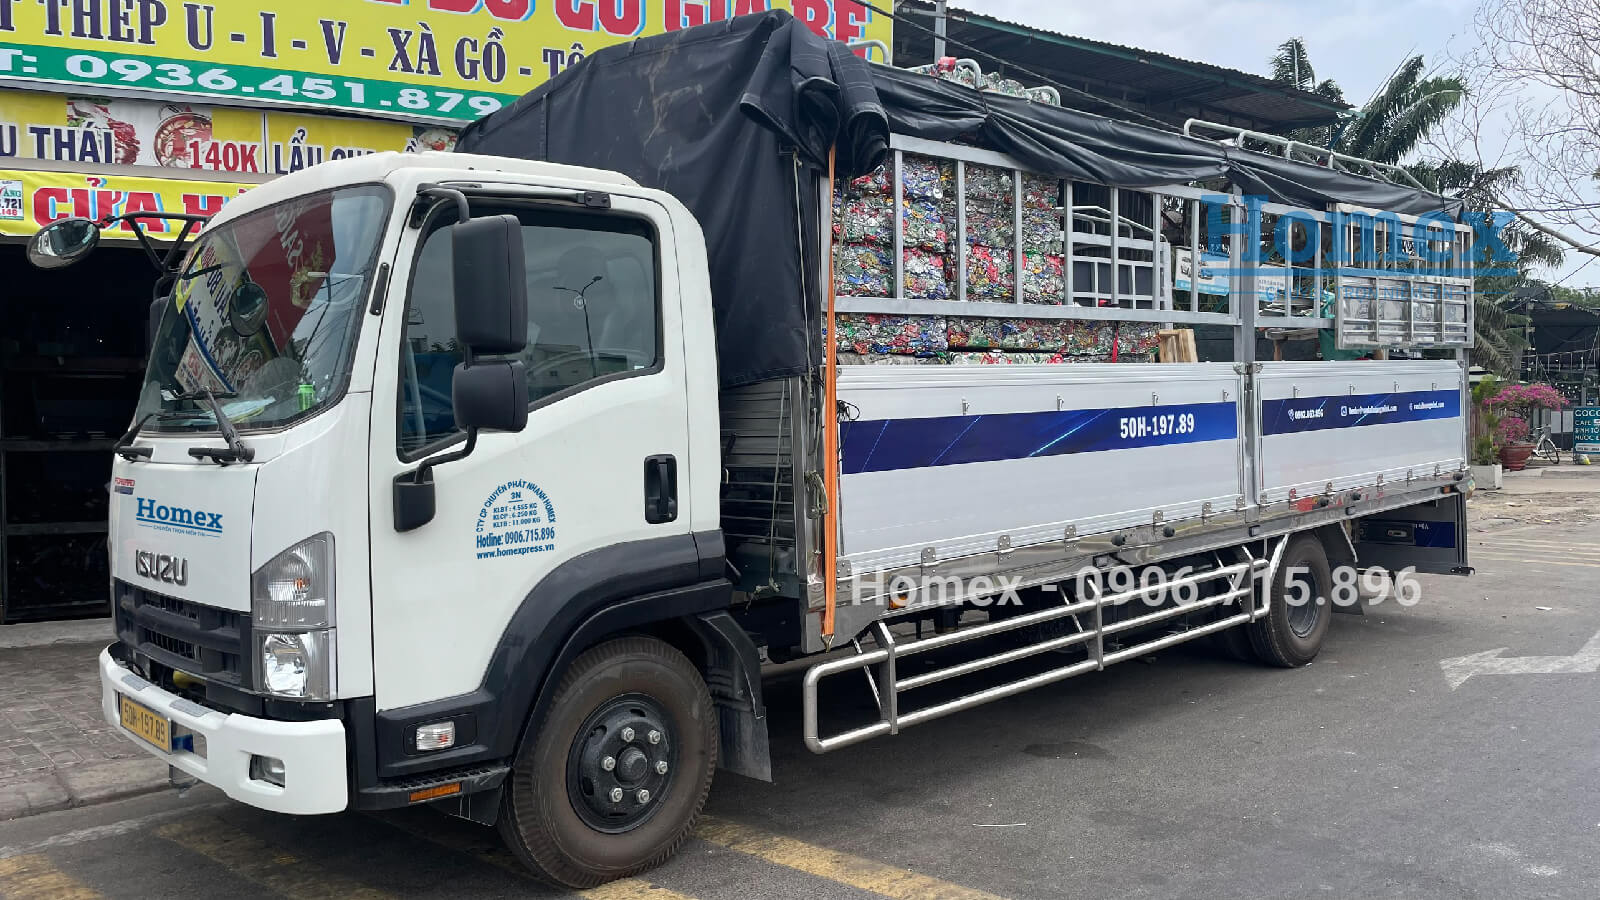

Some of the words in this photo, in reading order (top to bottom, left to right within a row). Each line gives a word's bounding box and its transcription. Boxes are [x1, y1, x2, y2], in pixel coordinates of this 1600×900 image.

[183, 3, 215, 50] U
[260, 12, 277, 57] I
[319, 20, 347, 64] V
[387, 22, 442, 76] XÀ
[66, 54, 503, 117] 0936.451.879
[29, 121, 115, 164] THÁI
[189, 140, 259, 175] 140K
[1119, 413, 1195, 439] 50H-197.89
[136, 497, 223, 530] Homex
[543, 498, 556, 523] HOMEX
[476, 533, 503, 548] Hotline:
[504, 527, 555, 544] 0906.715.896
[476, 543, 554, 559] www.homexpress.vn
[136, 549, 188, 586] ISUZU
